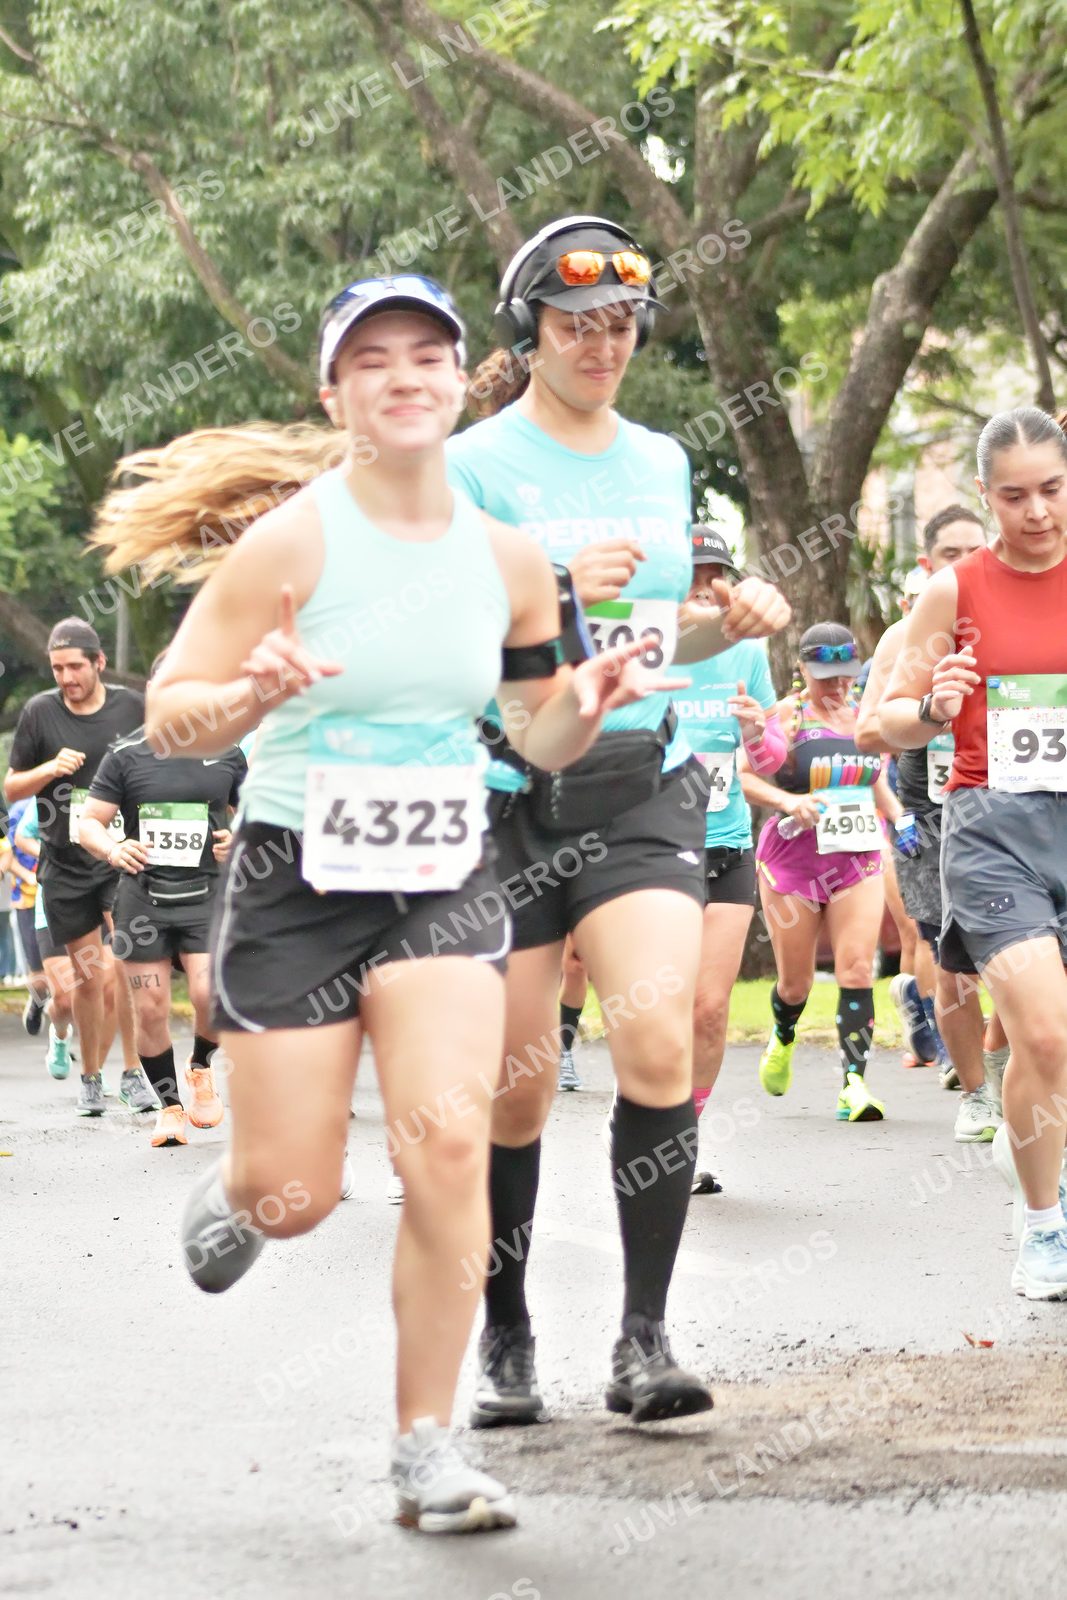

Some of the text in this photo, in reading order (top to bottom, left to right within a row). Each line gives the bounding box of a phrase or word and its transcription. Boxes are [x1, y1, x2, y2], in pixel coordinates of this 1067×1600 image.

[704, 537, 724, 551] RUN
[1012, 728, 1067, 764] 93
[322, 798, 469, 846] 4323
[822, 815, 877, 835] 4903
[146, 831, 203, 851] 1358
